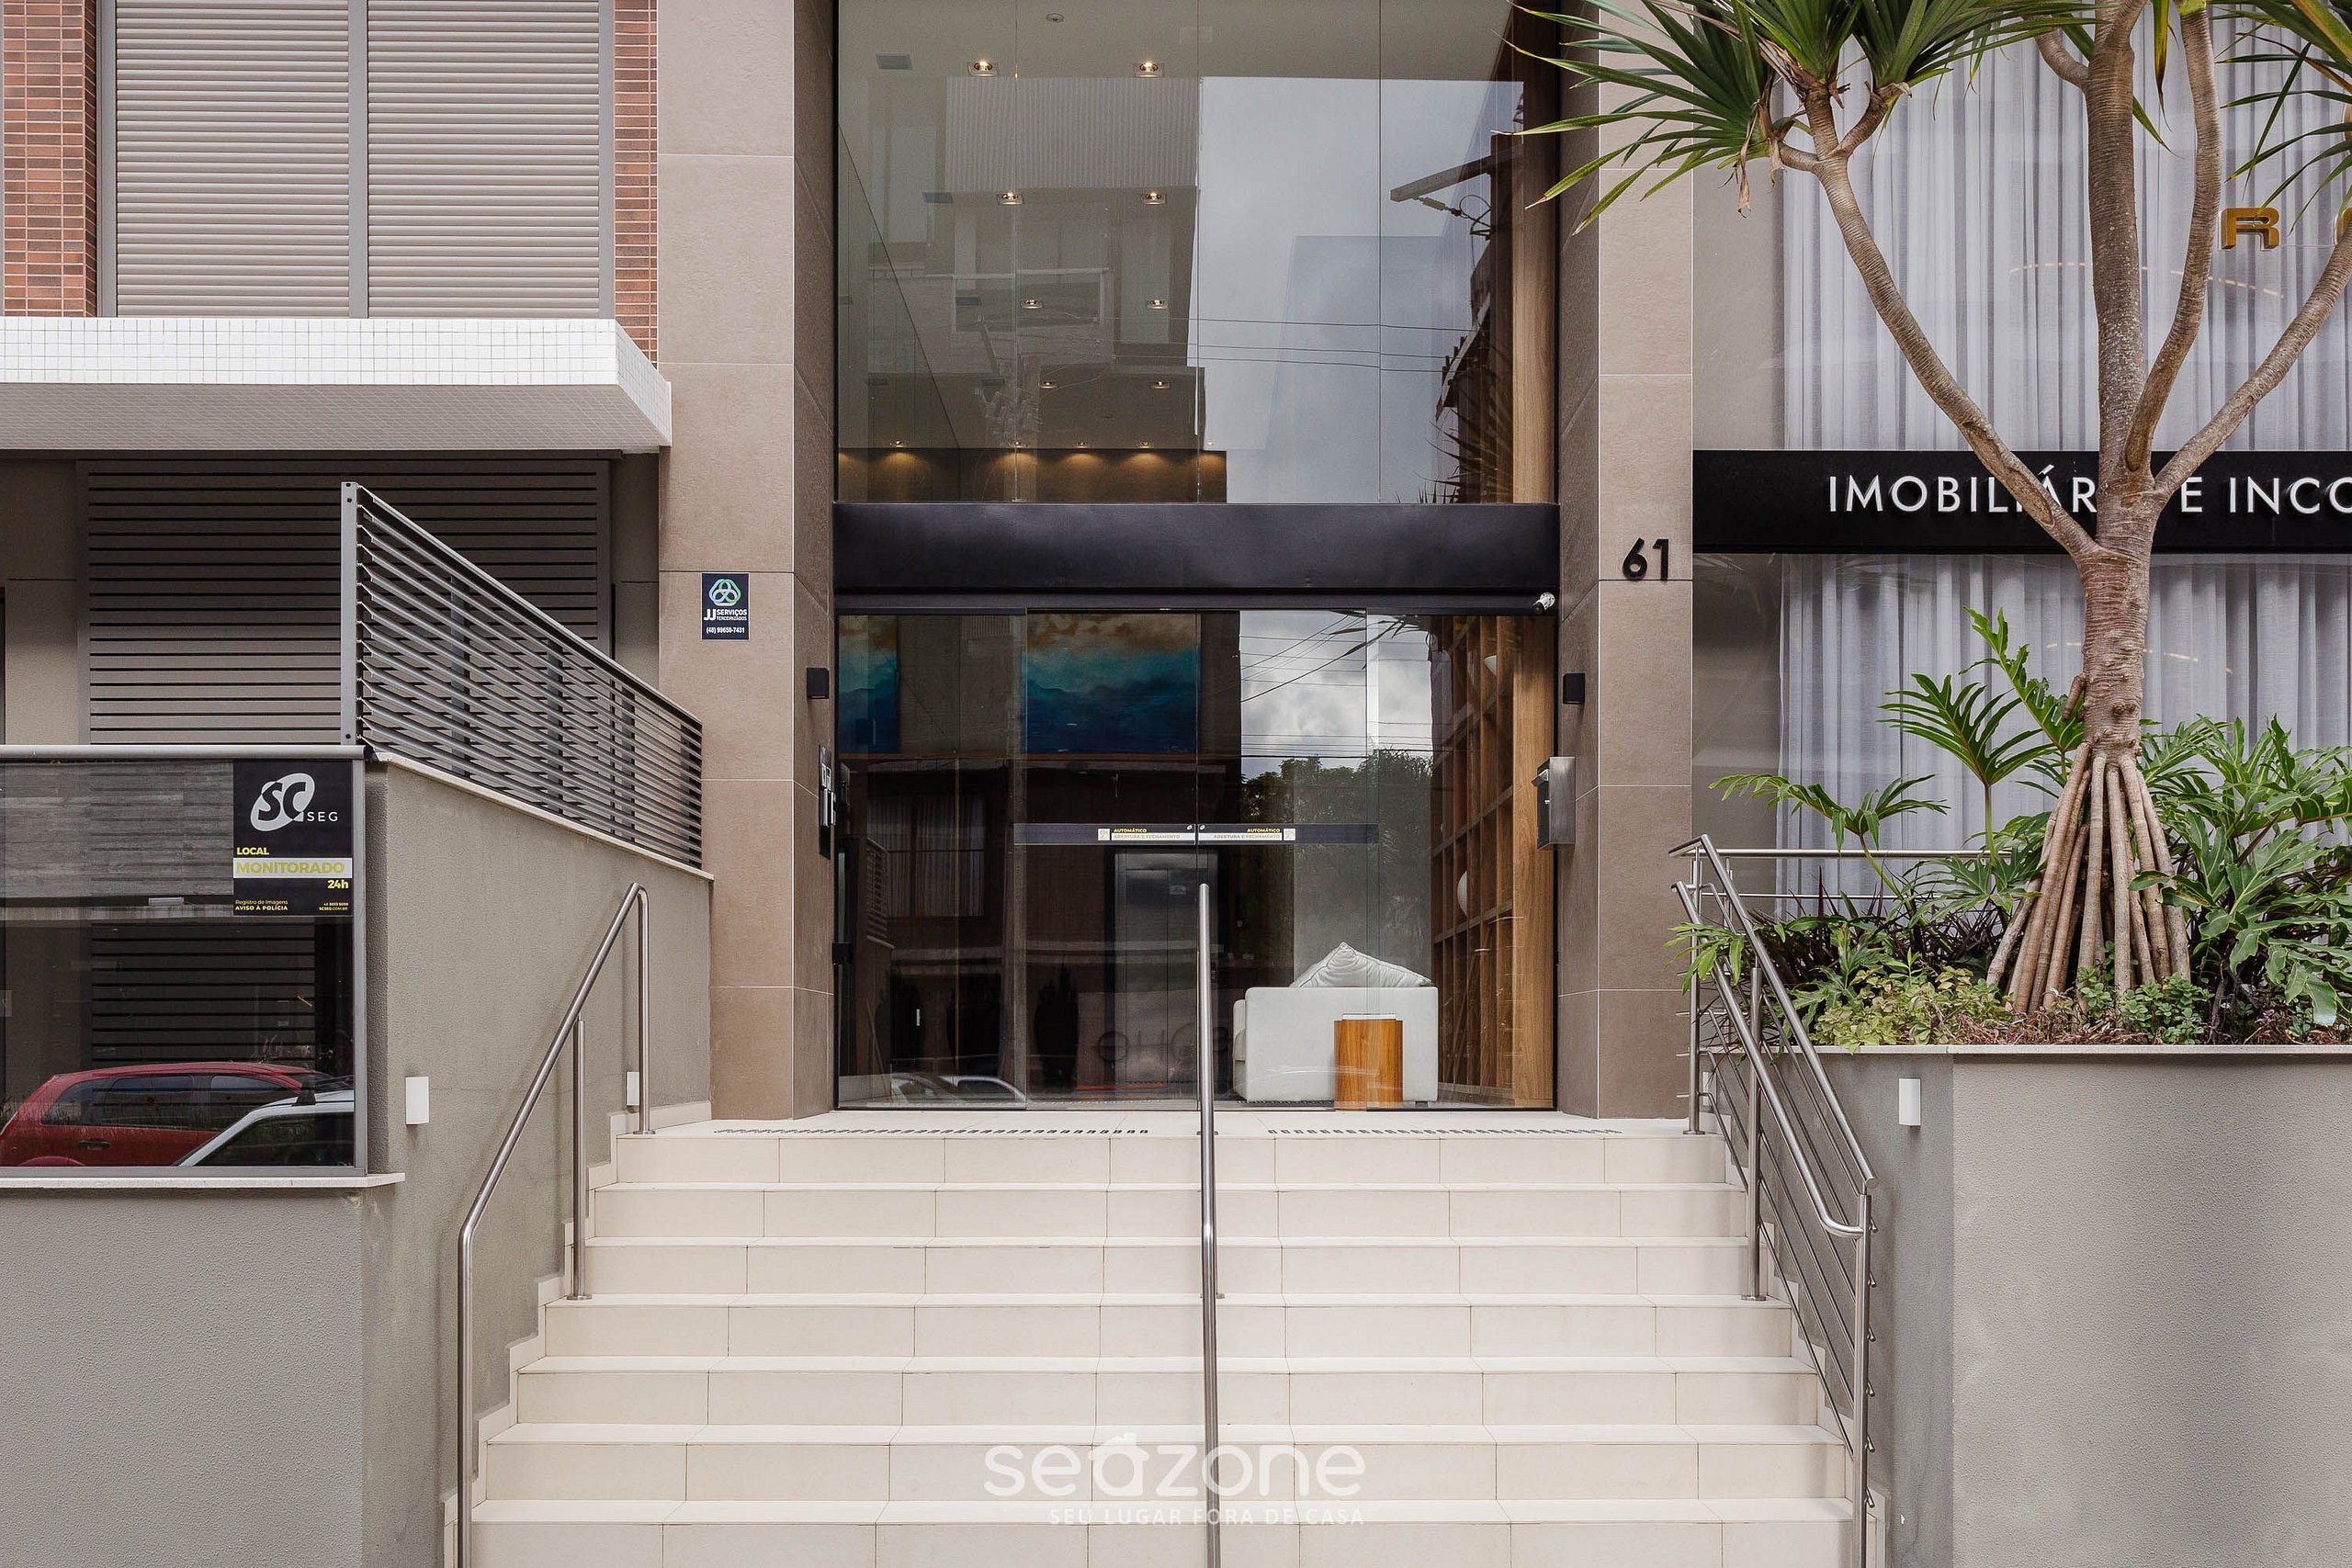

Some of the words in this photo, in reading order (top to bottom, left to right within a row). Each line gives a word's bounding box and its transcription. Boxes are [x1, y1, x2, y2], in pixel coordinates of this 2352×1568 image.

[2181, 476, 2202, 513] E
[1623, 537, 1668, 581] 61
[704, 608, 716, 621] JJ
[717, 609, 748, 617] SERVIÇOS
[307, 811, 338, 822] SEG
[236, 847, 270, 855] LOCAL
[236, 861, 345, 874] MONITORADO
[327, 879, 349, 889] 24h
